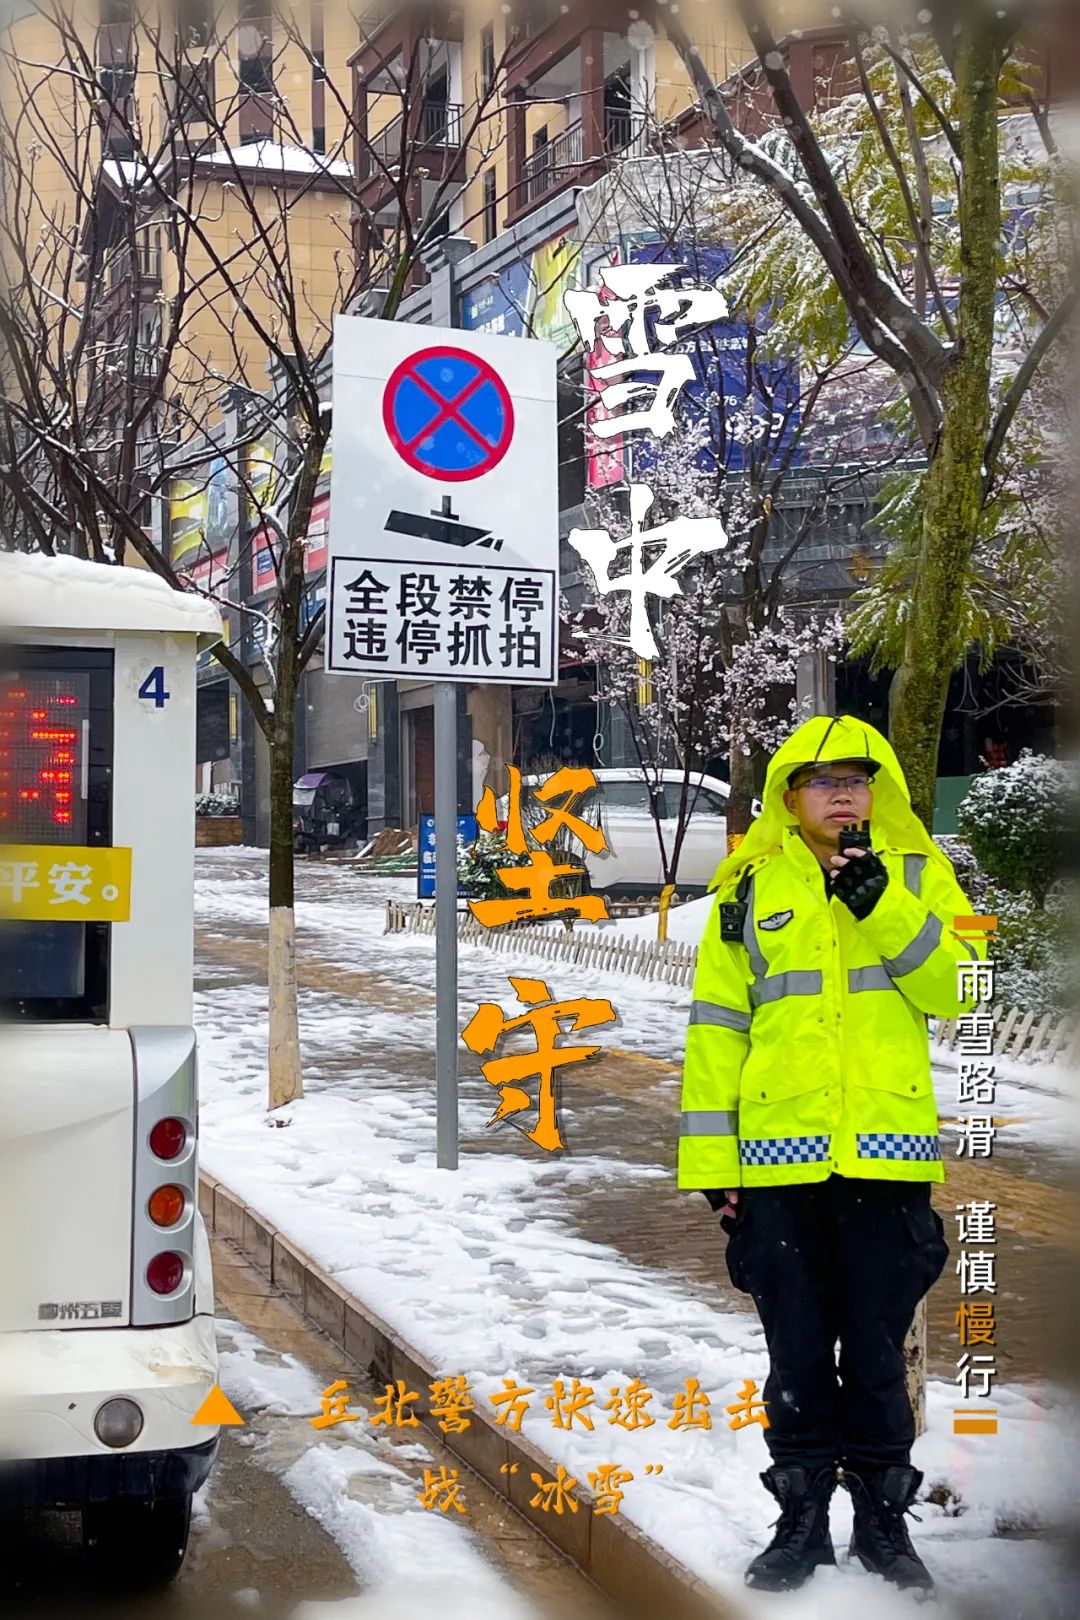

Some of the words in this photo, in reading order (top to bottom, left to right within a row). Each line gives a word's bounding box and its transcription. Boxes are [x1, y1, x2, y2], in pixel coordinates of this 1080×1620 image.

[343, 569, 544, 622] 全段禁停
[343, 618, 541, 668] 违停抓拍
[138, 666, 170, 708] 4
